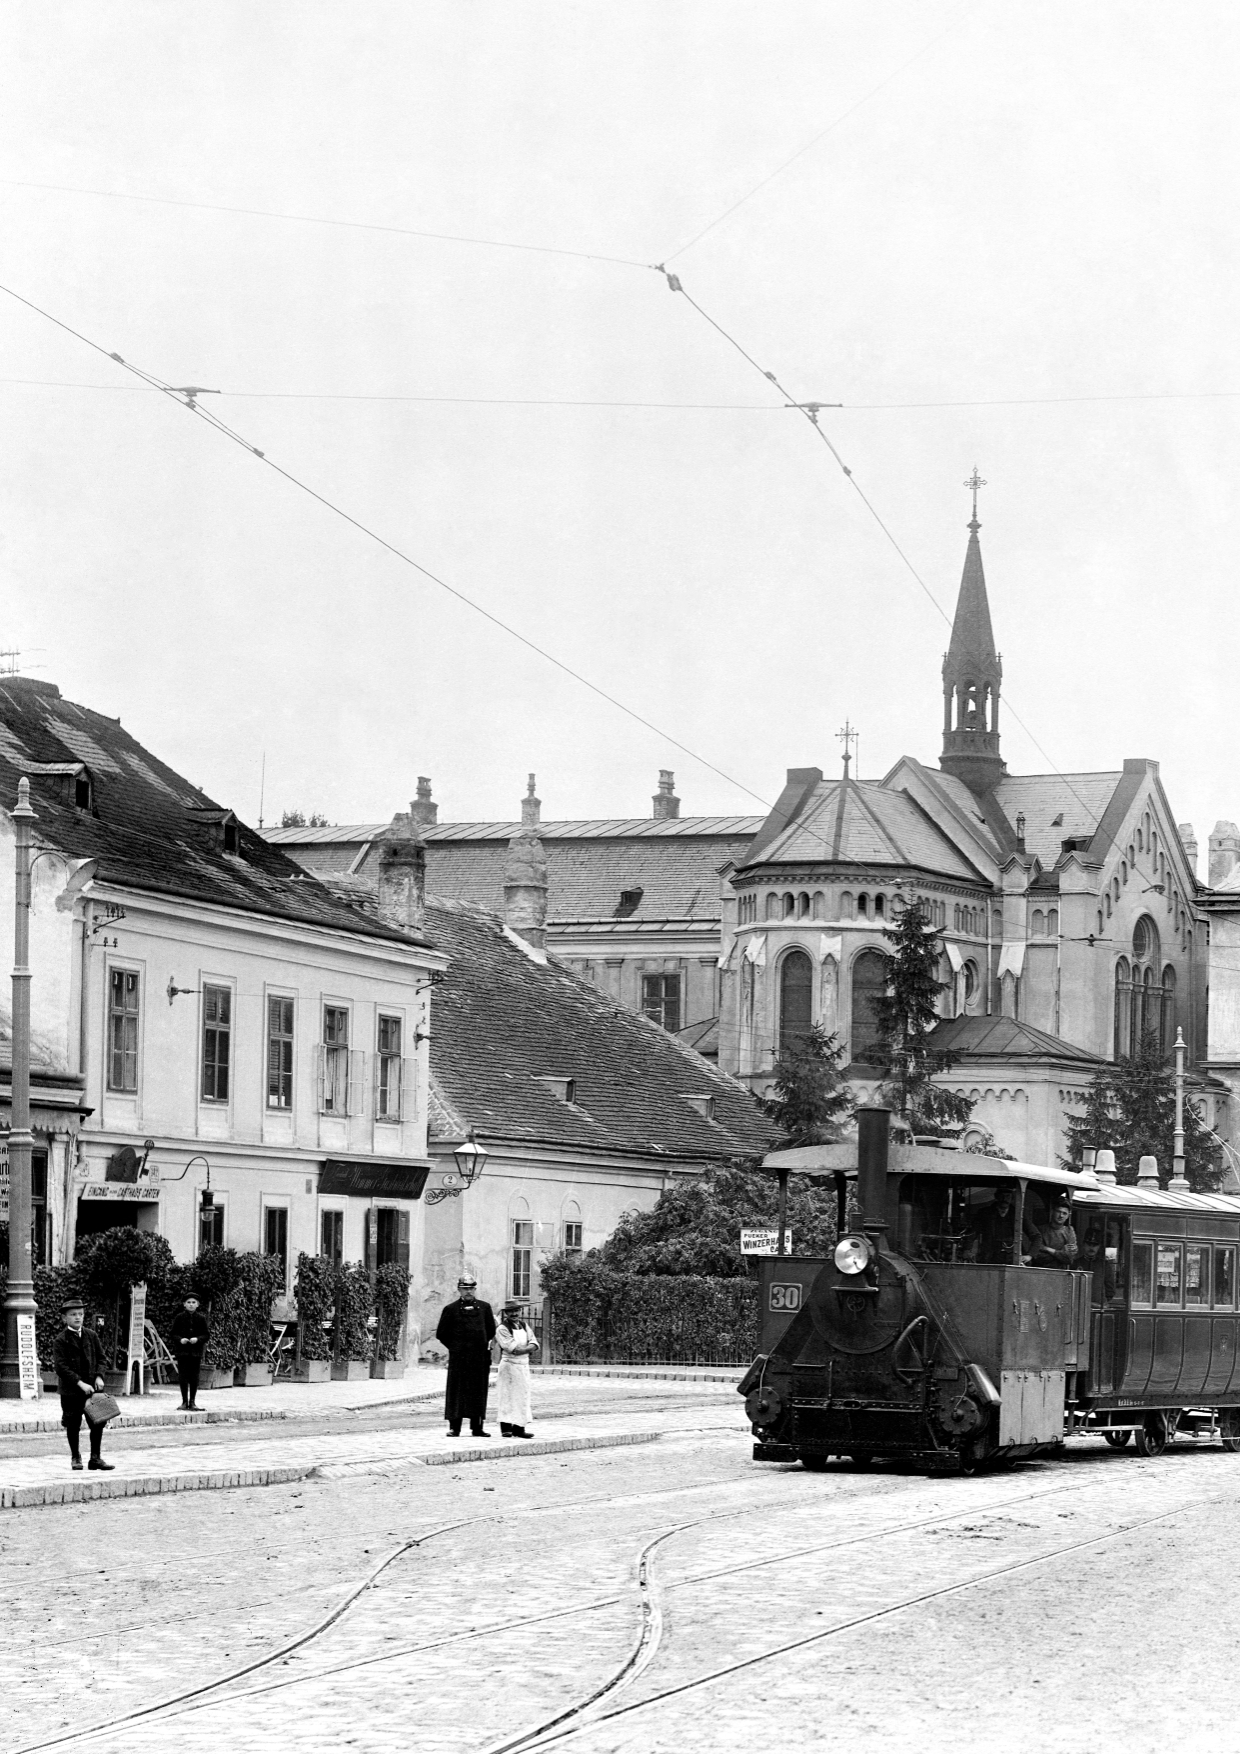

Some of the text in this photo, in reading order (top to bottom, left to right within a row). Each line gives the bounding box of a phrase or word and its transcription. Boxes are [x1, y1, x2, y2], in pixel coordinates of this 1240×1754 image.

[447, 1175, 453, 1184] 2
[87, 1186, 109, 1197] EINGANG
[117, 1187, 142, 1198] GASTHAUS
[141, 1187, 160, 1199] GARTEN
[742, 1235, 790, 1250] WINZERHAS
[771, 1286, 799, 1309] 30
[20, 1324, 35, 1391] RUDOLFSHEIM
